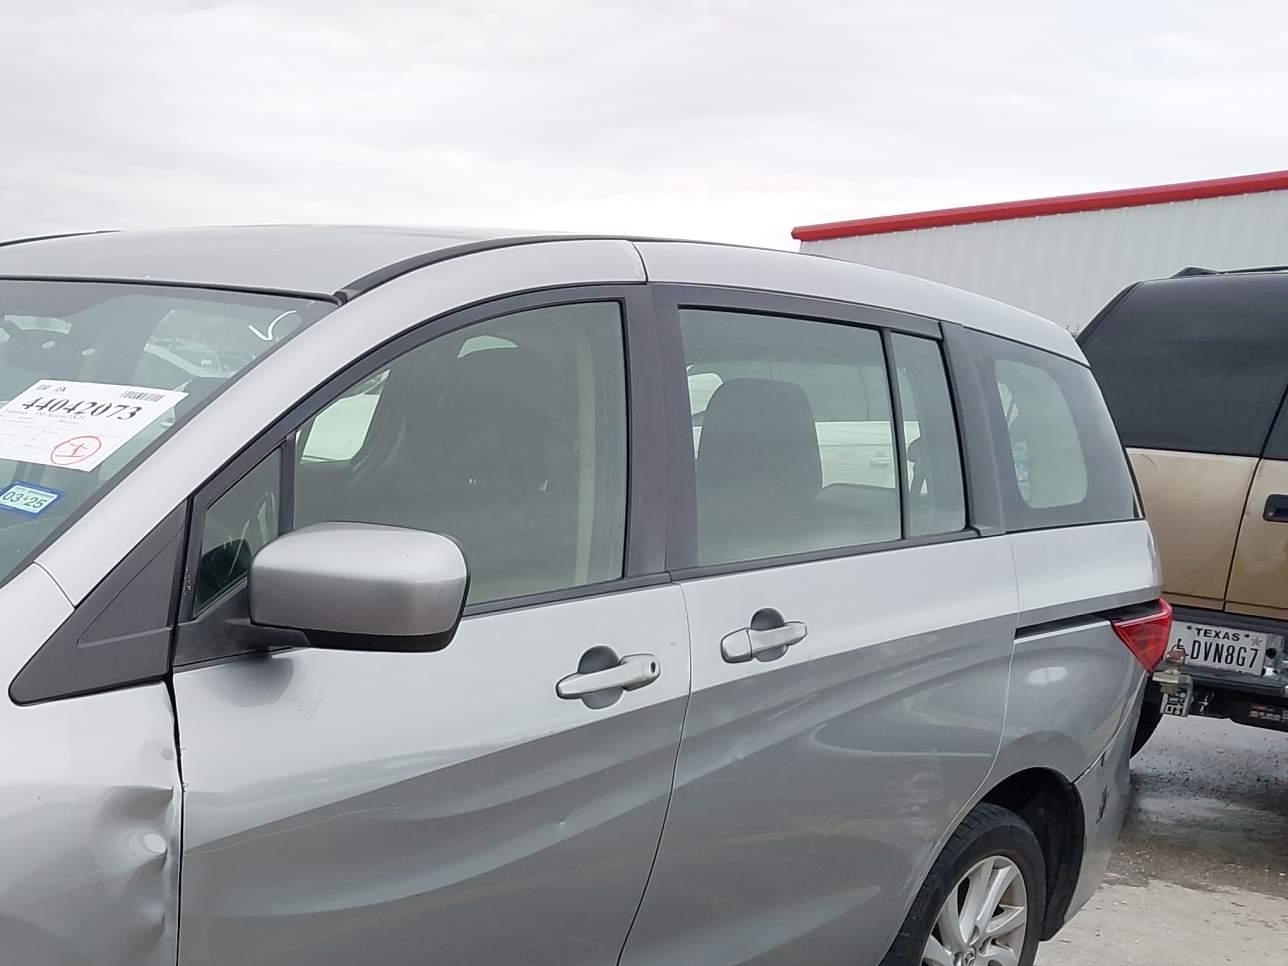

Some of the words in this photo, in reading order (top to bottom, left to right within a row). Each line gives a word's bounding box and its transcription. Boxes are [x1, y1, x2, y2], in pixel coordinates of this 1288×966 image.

[22, 396, 143, 421] 44042073
[1194, 627, 1241, 642] TEXAS
[1190, 639, 1259, 669] DVN8G7
